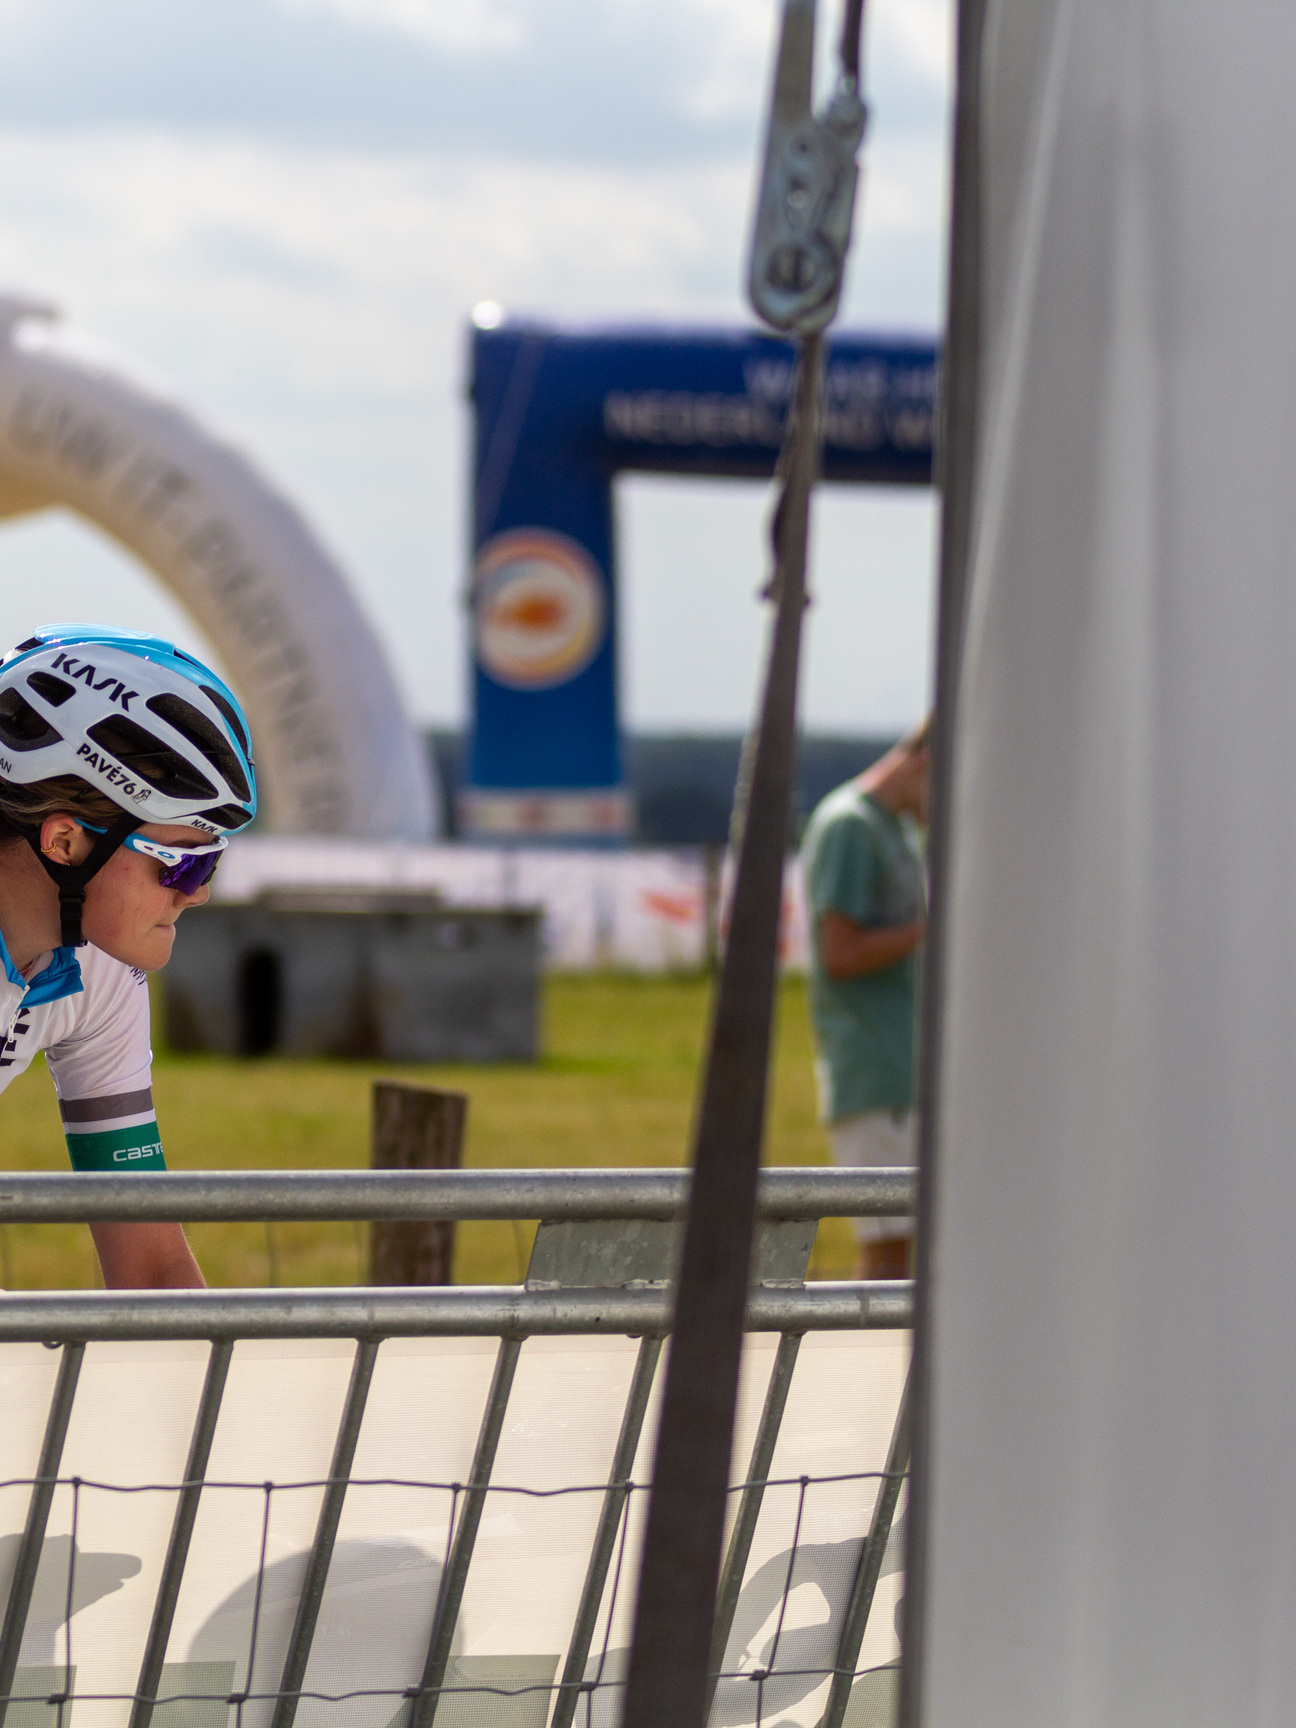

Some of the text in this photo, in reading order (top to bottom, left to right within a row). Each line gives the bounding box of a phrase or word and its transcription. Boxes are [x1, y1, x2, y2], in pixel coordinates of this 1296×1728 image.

[609, 395, 882, 444] NEDERLND
[51, 653, 139, 712] KASK
[77, 743, 136, 795] PAVÉ76
[191, 819, 218, 834] KASK
